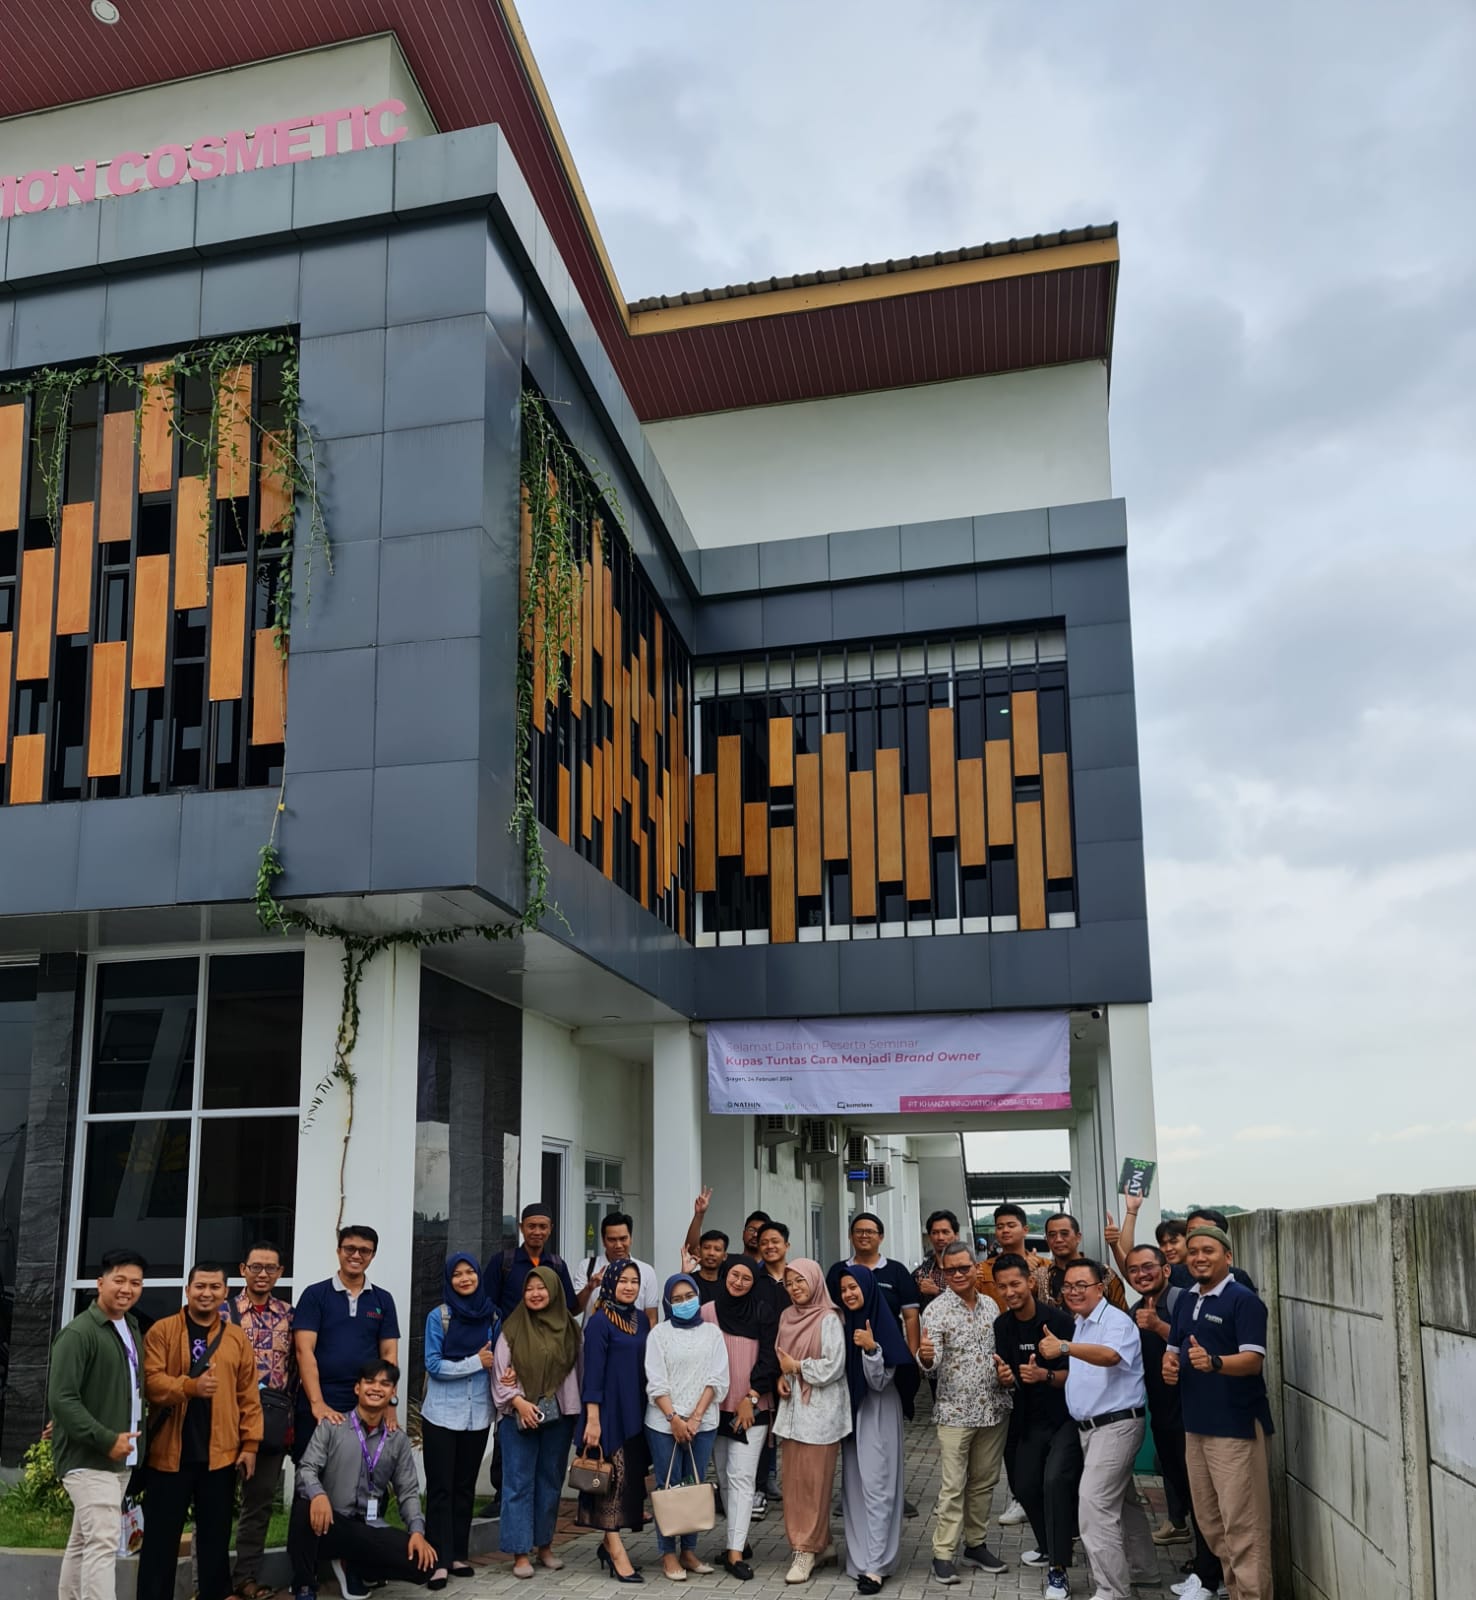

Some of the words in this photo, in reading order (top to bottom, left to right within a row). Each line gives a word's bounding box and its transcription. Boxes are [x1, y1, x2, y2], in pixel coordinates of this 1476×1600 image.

[0, 159, 97, 218] ION
[107, 98, 409, 196] COSMETIC
[775, 1041, 819, 1053] Datang
[822, 1040, 866, 1050] Peserta
[869, 1039, 918, 1049] Seminar
[726, 1055, 763, 1068] Kupas
[766, 1055, 807, 1066] Tuntas
[810, 1054, 838, 1065] Cara
[841, 1052, 891, 1066] Menjadi
[895, 1051, 934, 1063] Brand
[938, 1051, 981, 1062] Owner
